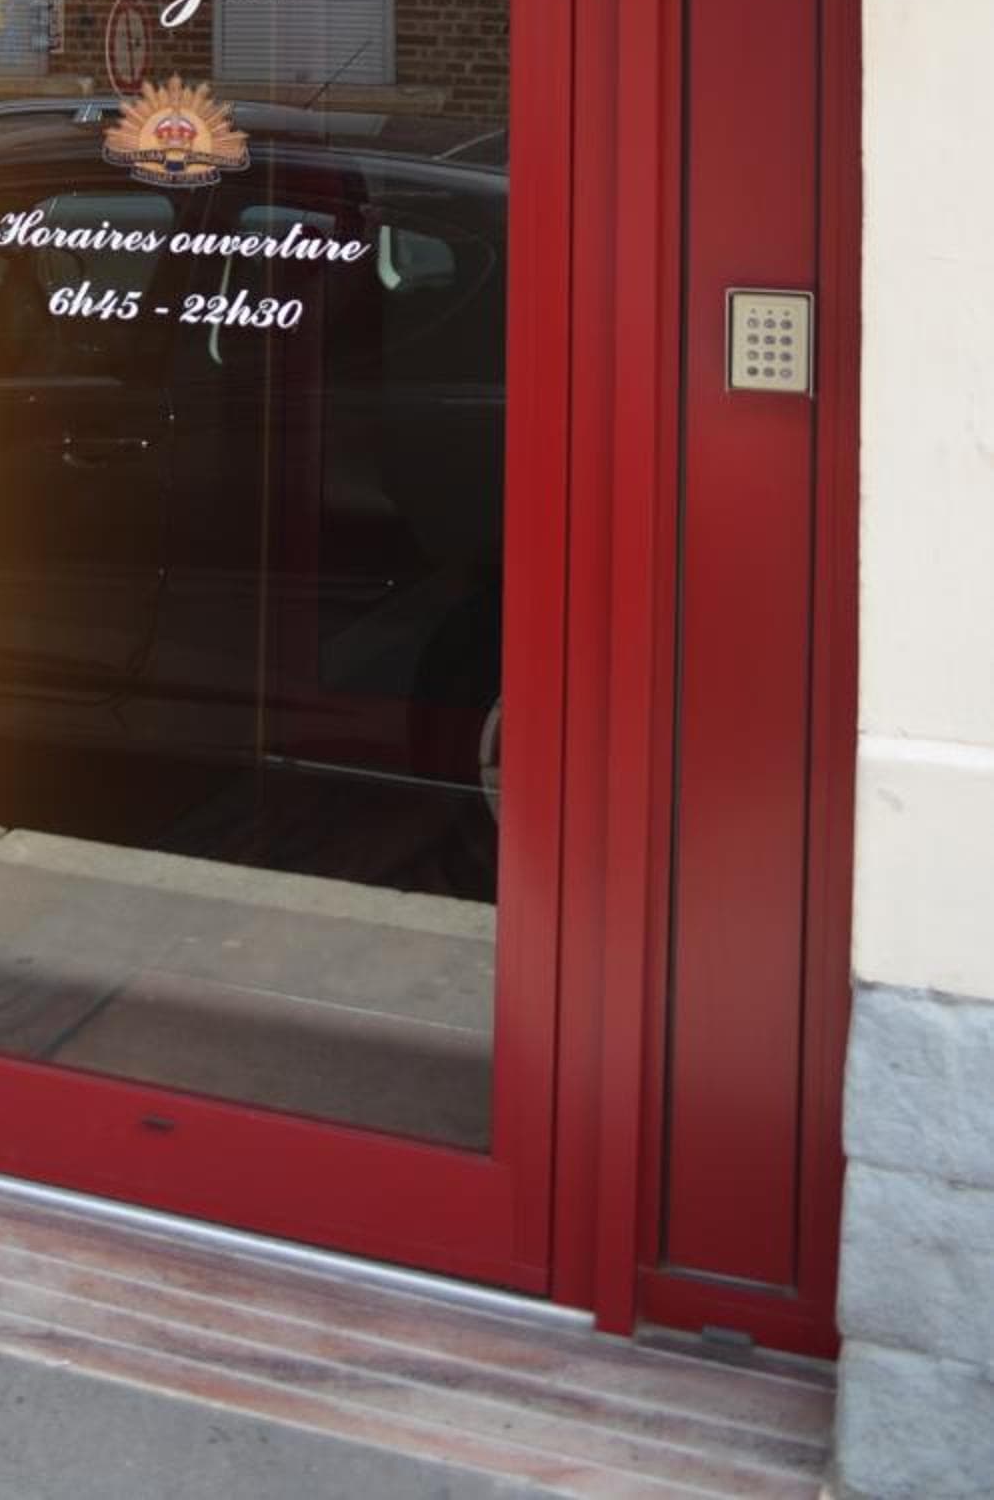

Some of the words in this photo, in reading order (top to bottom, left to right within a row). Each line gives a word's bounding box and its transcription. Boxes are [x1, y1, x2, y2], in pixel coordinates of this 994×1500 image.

[169, 222, 370, 262] ouverture
[48, 280, 143, 321] 6h45
[179, 288, 304, 329] 22h30
